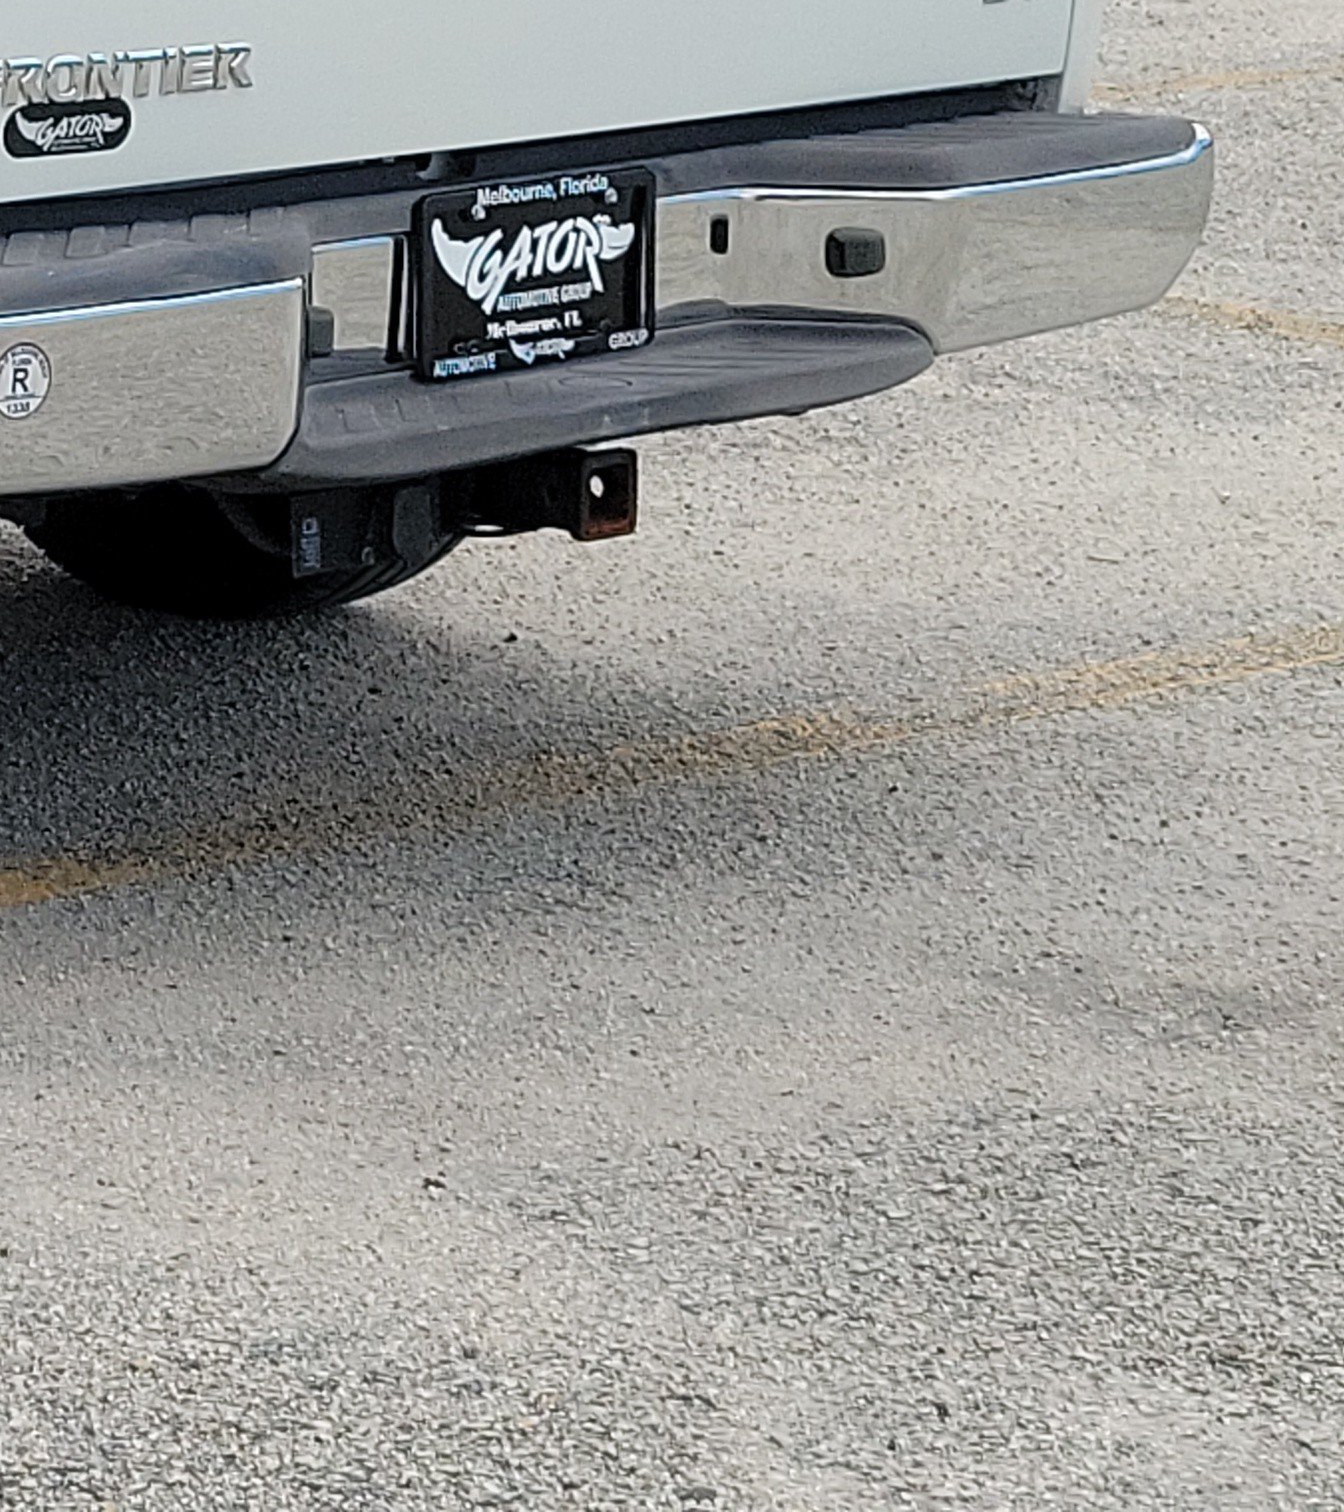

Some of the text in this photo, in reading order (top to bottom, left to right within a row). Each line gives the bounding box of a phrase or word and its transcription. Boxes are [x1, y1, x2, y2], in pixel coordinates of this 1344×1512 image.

[34, 113, 105, 152] GATOR
[477, 173, 609, 207] Melbourne, Florida
[466, 216, 605, 315] GATOR
[608, 327, 649, 350] GROUP
[12, 367, 30, 392] R
